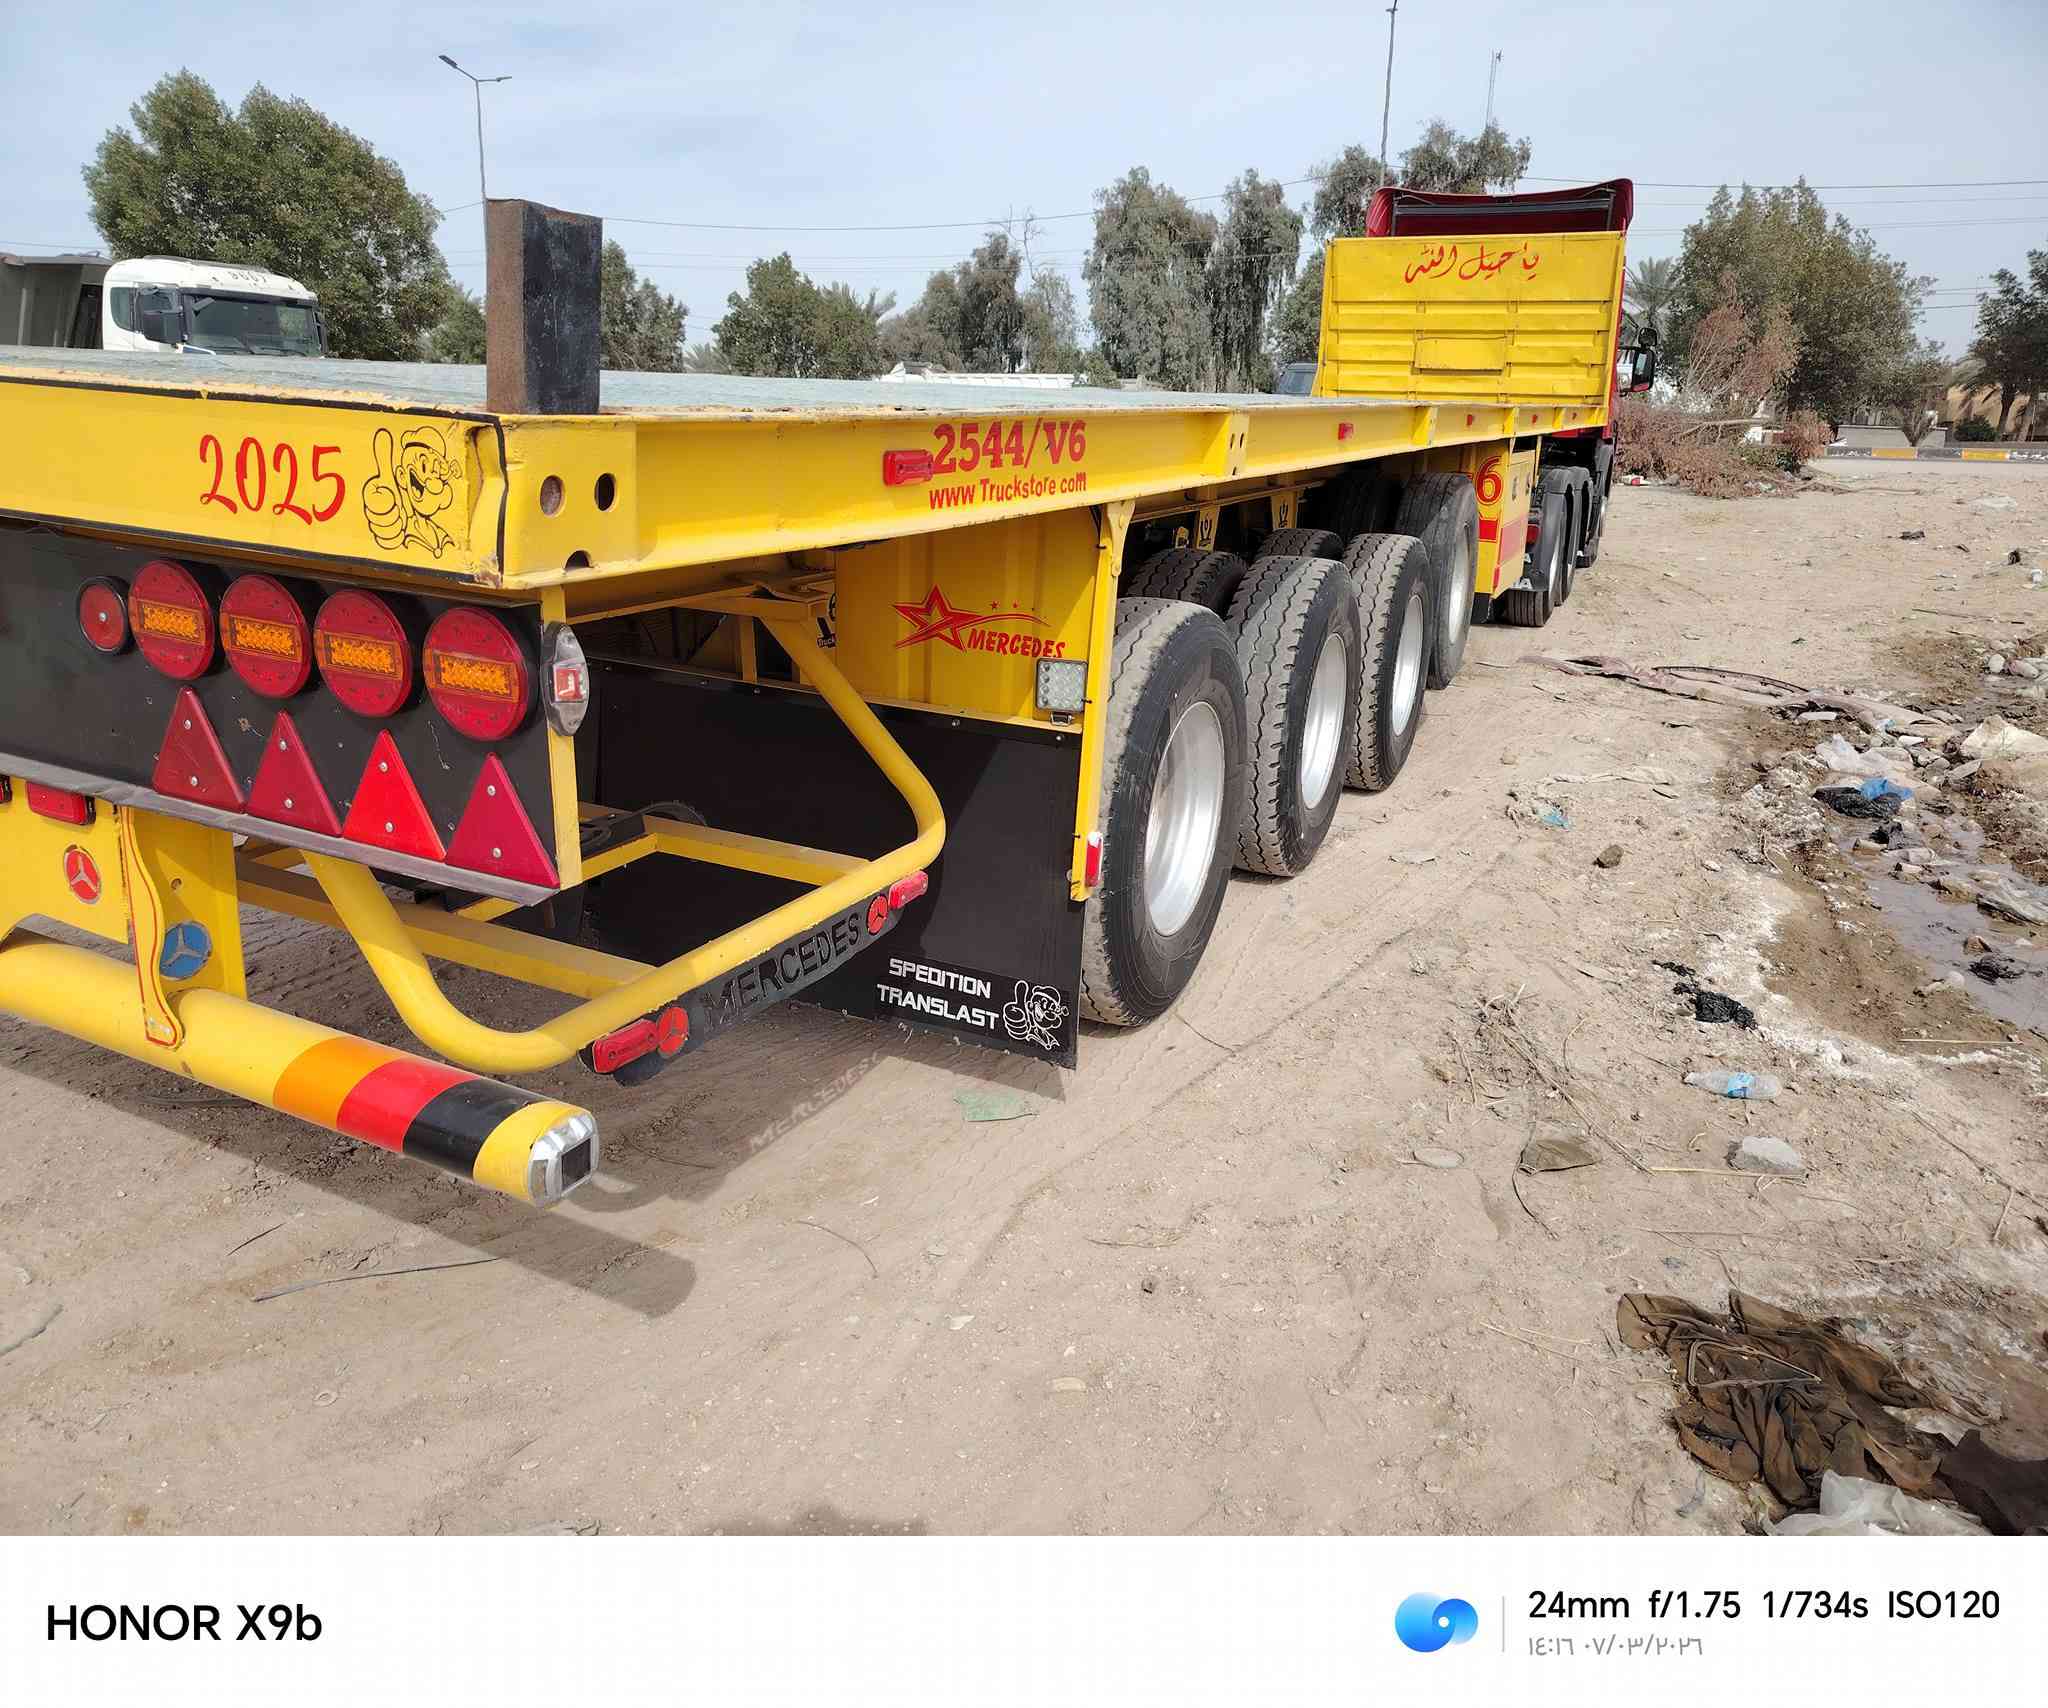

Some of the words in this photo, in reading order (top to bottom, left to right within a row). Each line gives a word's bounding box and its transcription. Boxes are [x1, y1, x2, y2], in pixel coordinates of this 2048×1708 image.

[933, 417, 1087, 475] 2544/V6
[198, 433, 346, 525] 2025
[929, 484, 976, 510] www
[979, 473, 1056, 502] Truckstore
[1060, 472, 1087, 494] com
[967, 627, 1066, 659] MERCEDES
[702, 912, 861, 1024] MERCEDES
[889, 957, 992, 1000] SPEDITION
[876, 983, 1000, 1031] TRANSLAST
